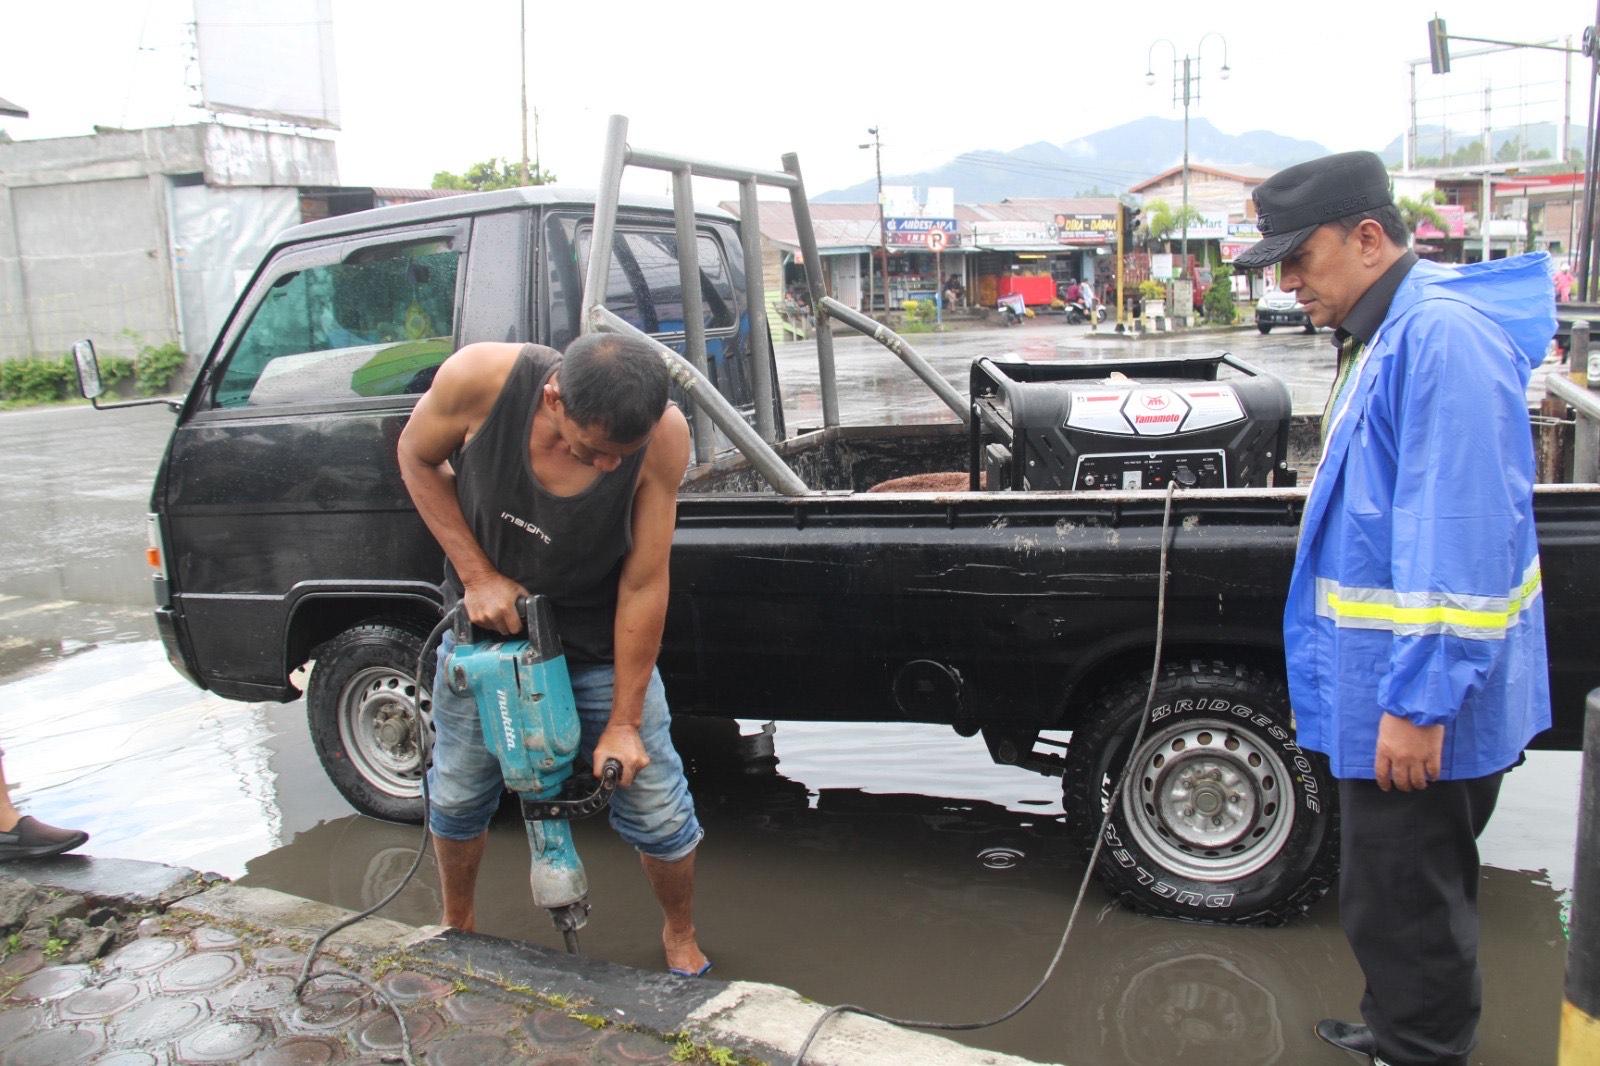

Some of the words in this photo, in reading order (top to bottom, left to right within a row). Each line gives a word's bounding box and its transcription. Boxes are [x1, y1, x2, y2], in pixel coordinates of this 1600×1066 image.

[1135, 414, 1180, 424] Yamamoto
[500, 511, 552, 545] insight
[496, 689, 516, 748] makita
[1152, 699, 1320, 814] BRIDGESTONE
[1101, 772, 1112, 815] M/T
[1103, 823, 1235, 908] DUELER
